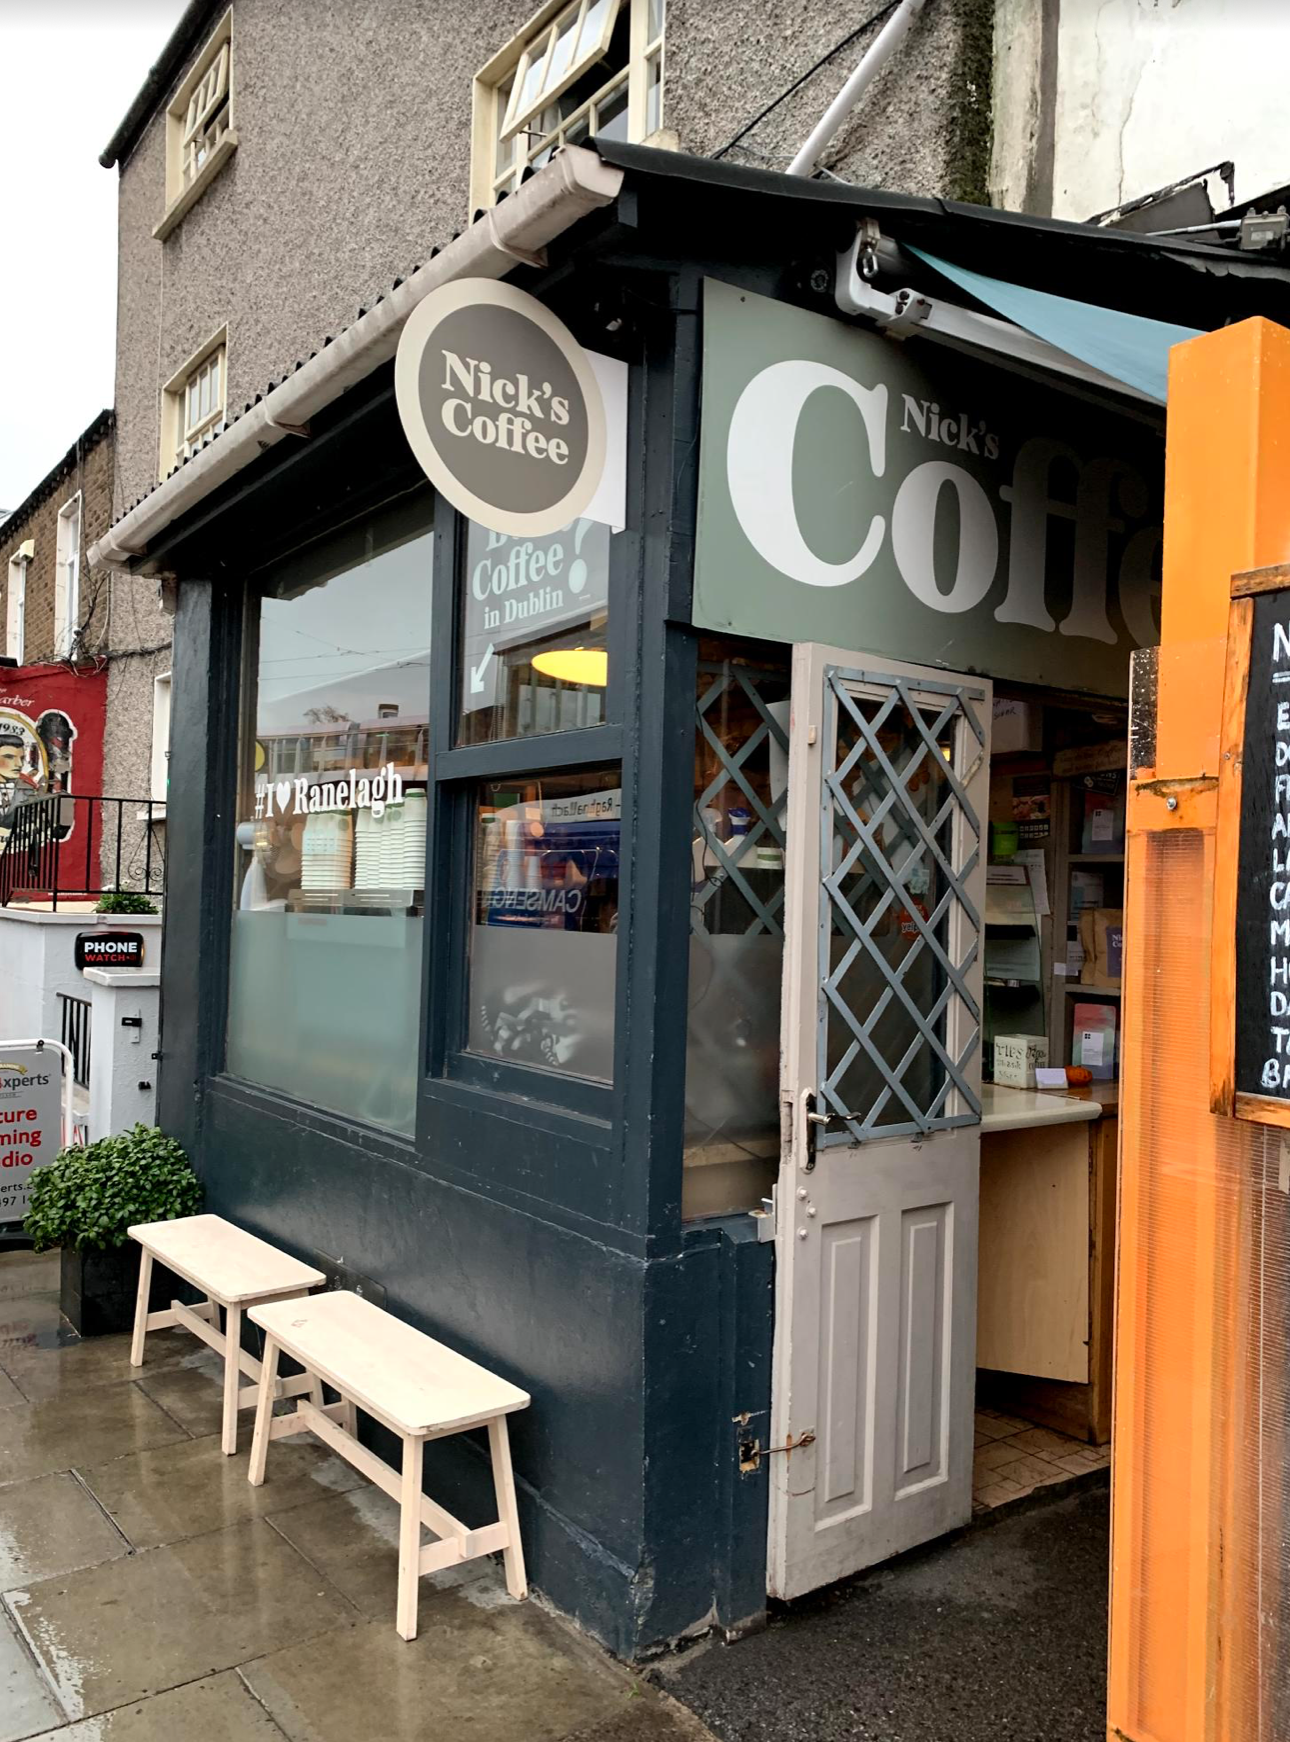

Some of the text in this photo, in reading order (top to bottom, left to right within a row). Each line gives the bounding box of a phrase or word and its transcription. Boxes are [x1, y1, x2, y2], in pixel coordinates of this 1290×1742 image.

[441, 350, 570, 425] Nick's
[441, 398, 569, 465] Coffee
[900, 393, 999, 460] Nick's
[484, 586, 564, 629] in Dublin
[293, 762, 404, 818] Ranelagh
[84, 941, 138, 953] PHONE
[85, 953, 126, 962] WATCH
